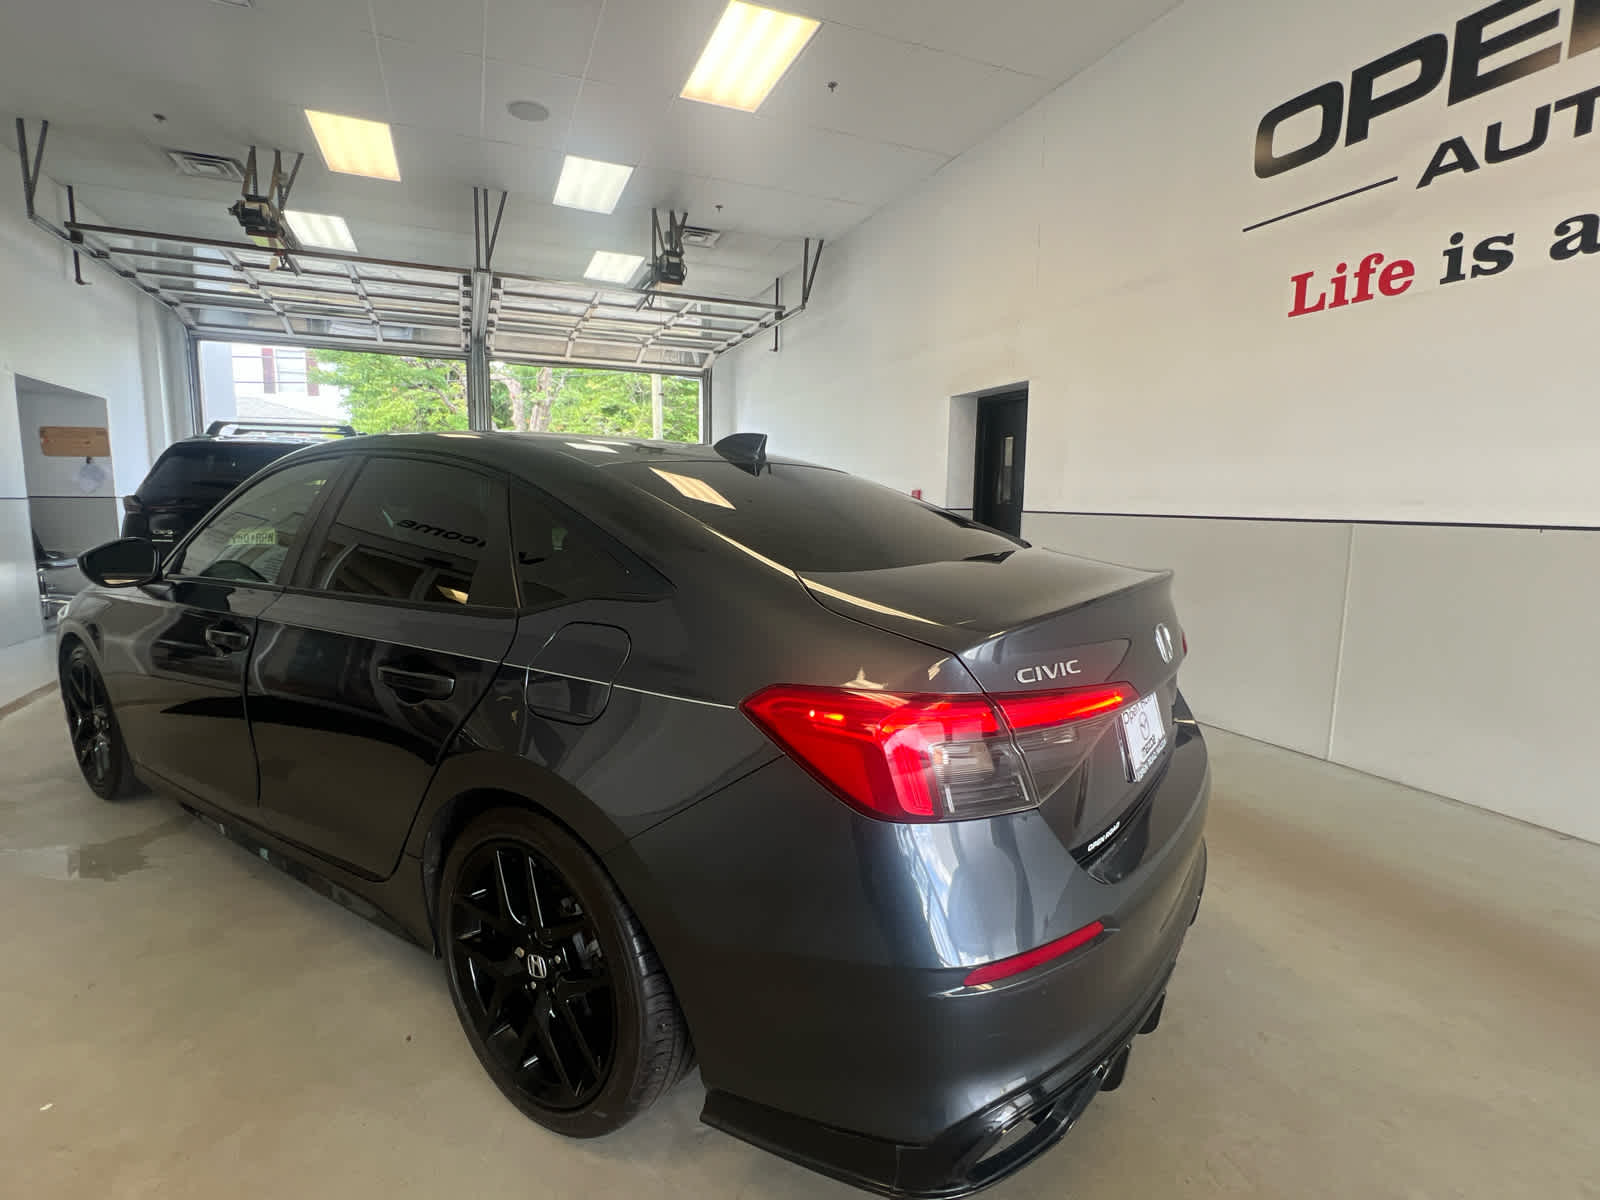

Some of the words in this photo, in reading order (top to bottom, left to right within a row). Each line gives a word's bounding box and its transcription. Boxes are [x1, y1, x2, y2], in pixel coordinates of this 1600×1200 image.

[1288, 252, 1415, 317] Life
[1439, 232, 1515, 285] is
[1550, 213, 1600, 260] a
[1015, 659, 1081, 684] CIVIC
